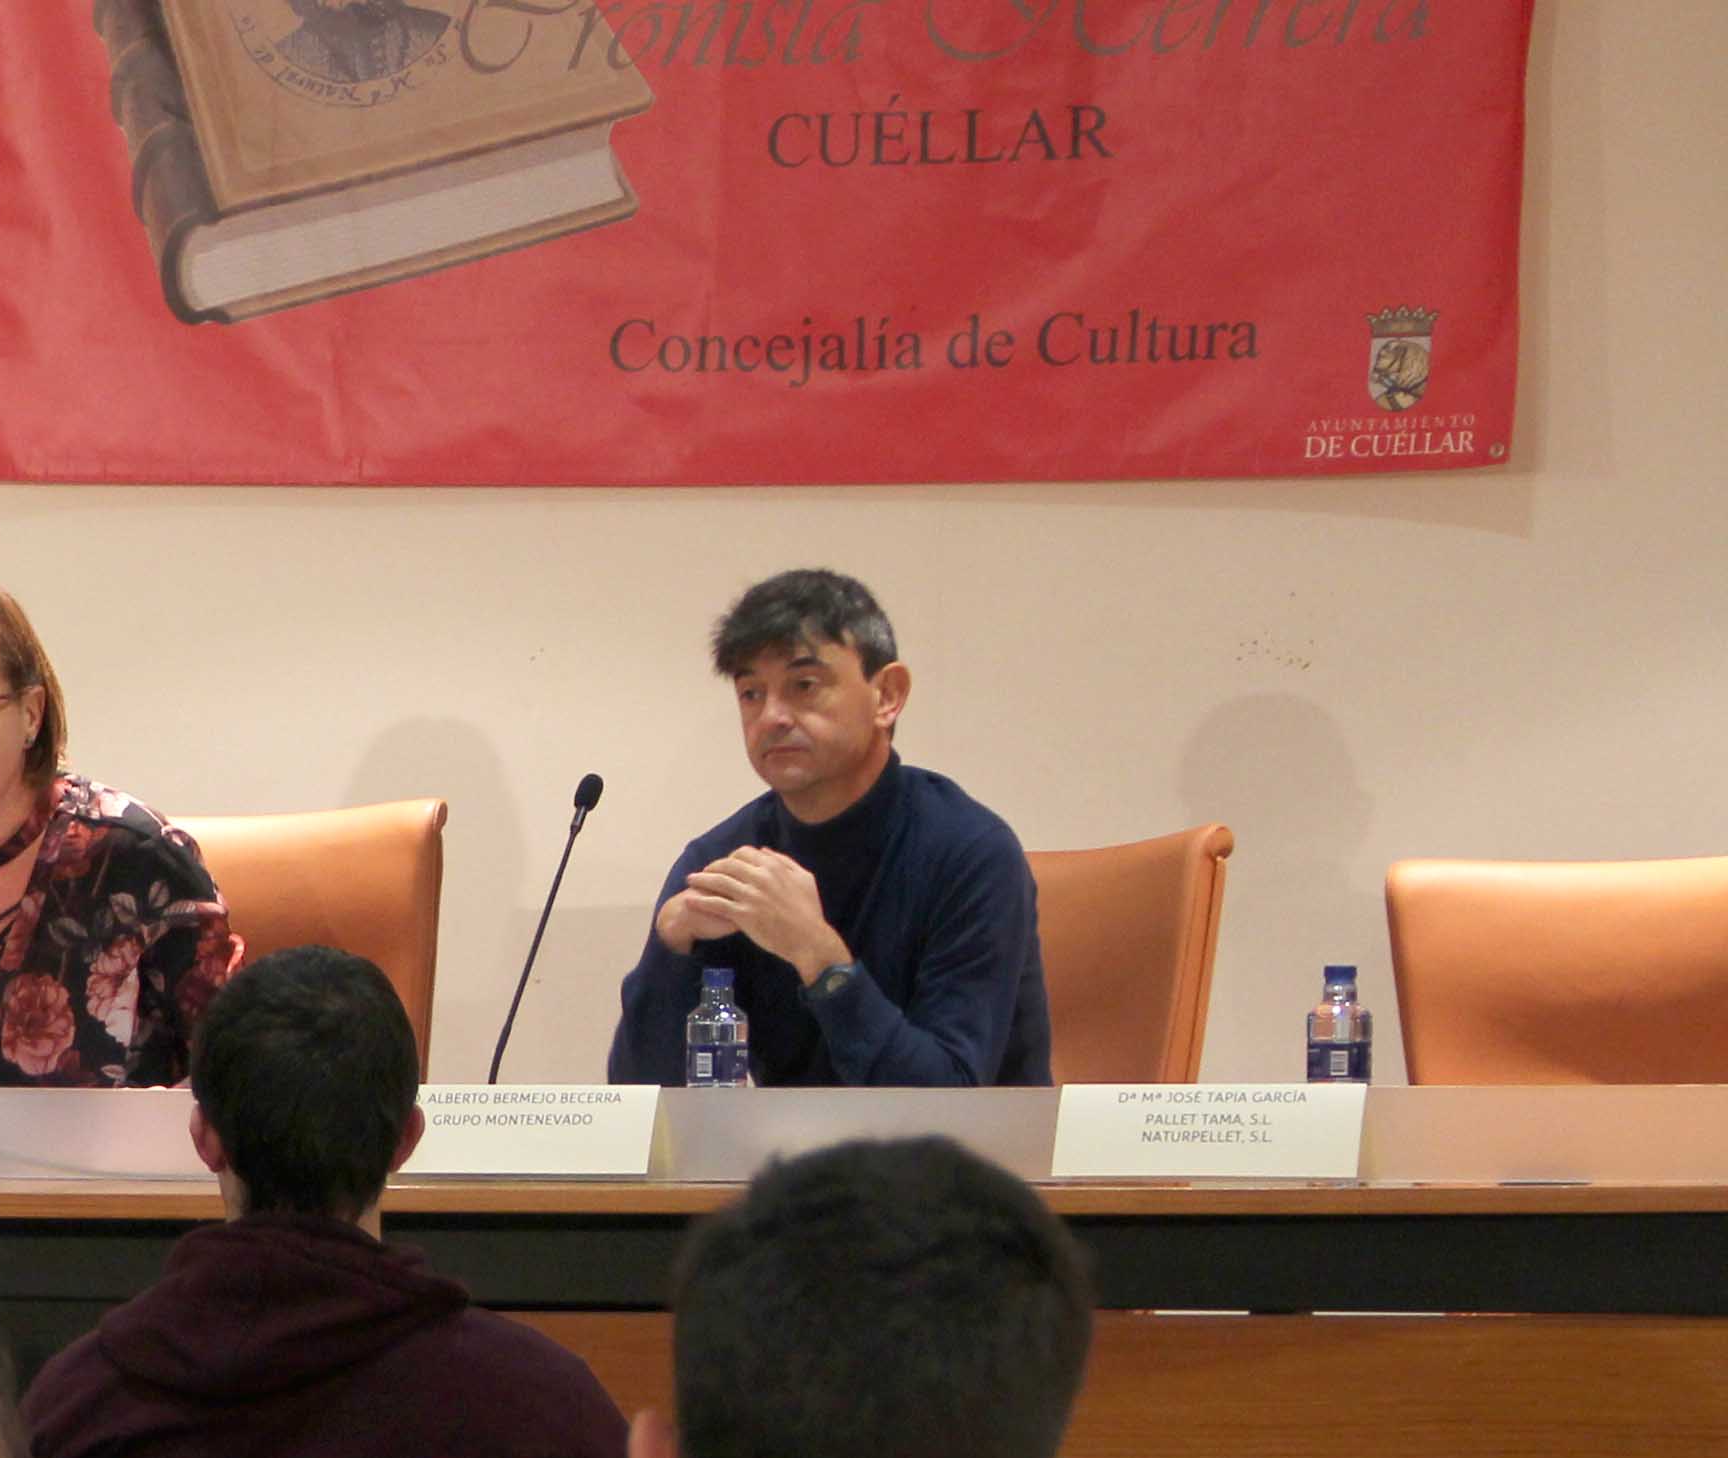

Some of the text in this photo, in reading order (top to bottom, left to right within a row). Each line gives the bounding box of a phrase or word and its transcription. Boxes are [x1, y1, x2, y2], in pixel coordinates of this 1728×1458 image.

[767, 93, 1115, 169] CUÉLLAR
[609, 308, 1260, 388] Concejalía de Cultura
[1307, 414, 1476, 432] AYUNTAMIENTO
[1304, 430, 1475, 459] DE CUÉLLAR
[428, 1092, 489, 1104] ALBERTO
[493, 1092, 557, 1104] BERMEJO
[560, 1092, 622, 1104] BECERRA
[1166, 1090, 1204, 1104] JOSÉ
[1207, 1091, 1248, 1104] TAPIA
[1251, 1089, 1308, 1104] GARCÍA
[432, 1113, 594, 1126] GRUPO MONTENEVADO
[1144, 1113, 1197, 1126] PALLET
[1201, 1113, 1246, 1127] TAMA,
[1141, 1130, 1246, 1144] NATURPELLET,
